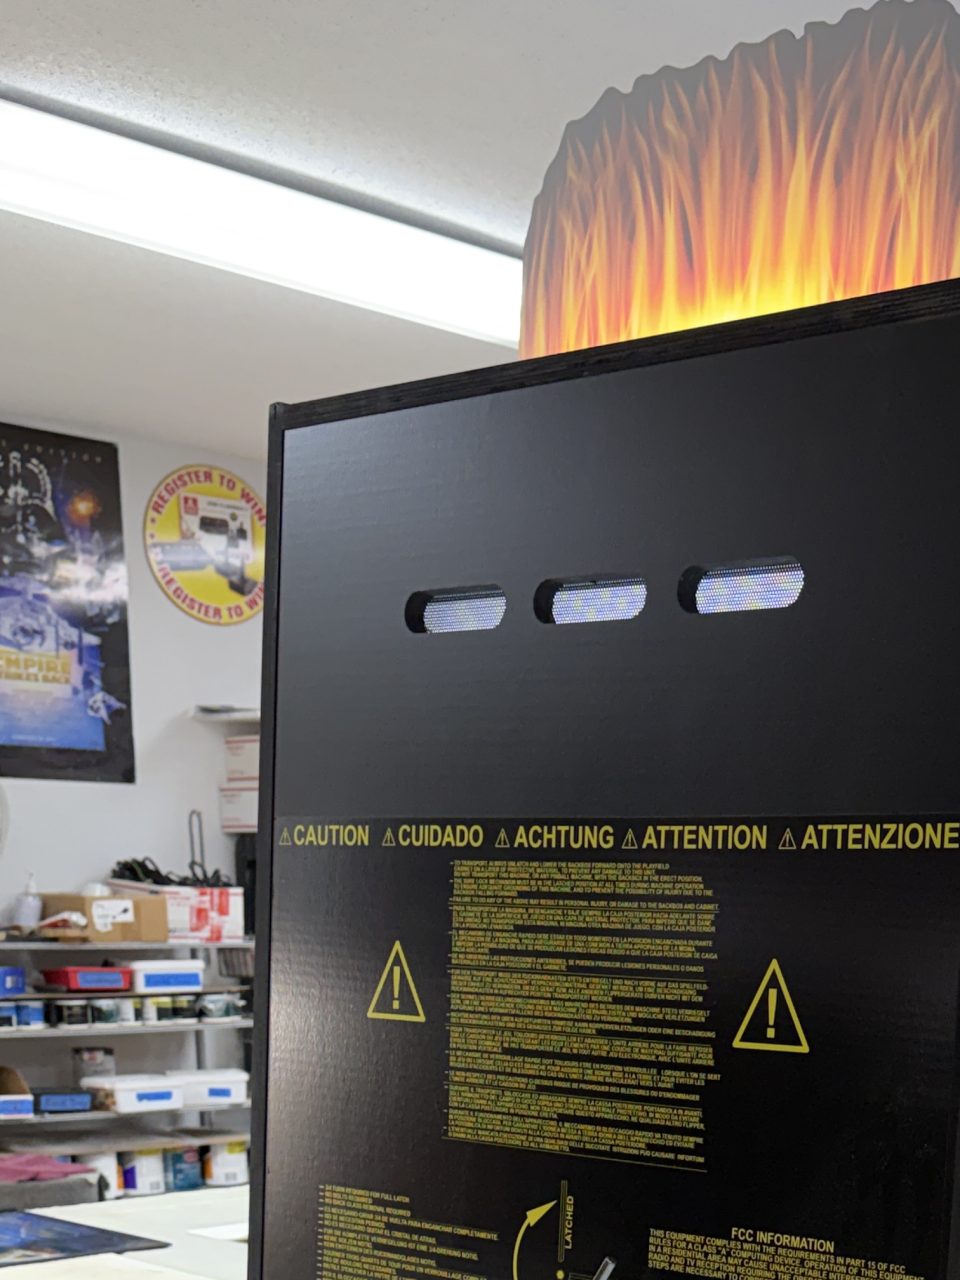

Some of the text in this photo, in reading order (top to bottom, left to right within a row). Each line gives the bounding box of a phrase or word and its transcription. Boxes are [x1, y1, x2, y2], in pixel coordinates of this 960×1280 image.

[152, 470, 213, 515] REGISTER
[220, 474, 236, 491] TO
[157, 563, 222, 619] REGISTER
[227, 604, 244, 619] TO
[293, 822, 960, 849] CAUTION CUIDADO ACHTUNG ATTENTION ATTENZIONE
[565, 1195, 574, 1249] LATCHED
[731, 1227, 834, 1253] FCC INFORMATION
[648, 1244, 656, 1252] IN
[662, 1247, 706, 1260] RESIDENTIAL
[707, 1253, 727, 1263] AREA
[727, 1256, 743, 1265] MAY
[743, 1259, 768, 1269] CAUSE
[769, 1263, 828, 1279] UNACCEPTABLE
[648, 1252, 670, 1262] RADIO
[670, 1255, 685, 1265] AND
[686, 1257, 695, 1266] TV
[696, 1260, 735, 1272] RECEPTION
[737, 1264, 776, 1278] REQUIRING
[777, 1271, 792, 1280] THE
[648, 1260, 669, 1270] STEPS
[670, 1264, 685, 1273] ARE
[686, 1266, 727, 1280] NECESSARY
[727, 1272, 738, 1280] TO
[649, 1236, 672, 1248] RULES
[672, 1240, 687, 1249] FOR
[688, 1241, 693, 1250] A
[694, 1243, 717, 1254] CLASS
[731, 1248, 773, 1261] COMPUTING
[804, 1260, 847, 1273] OPERATION
[848, 1265, 859, 1275] OF
[861, 1267, 878, 1278] THIS
[650, 1228, 906, 1275] THIS EQUIPMENT COMPLIES WITH THE REQUIREMENTS IN PART 15 OF FCC
